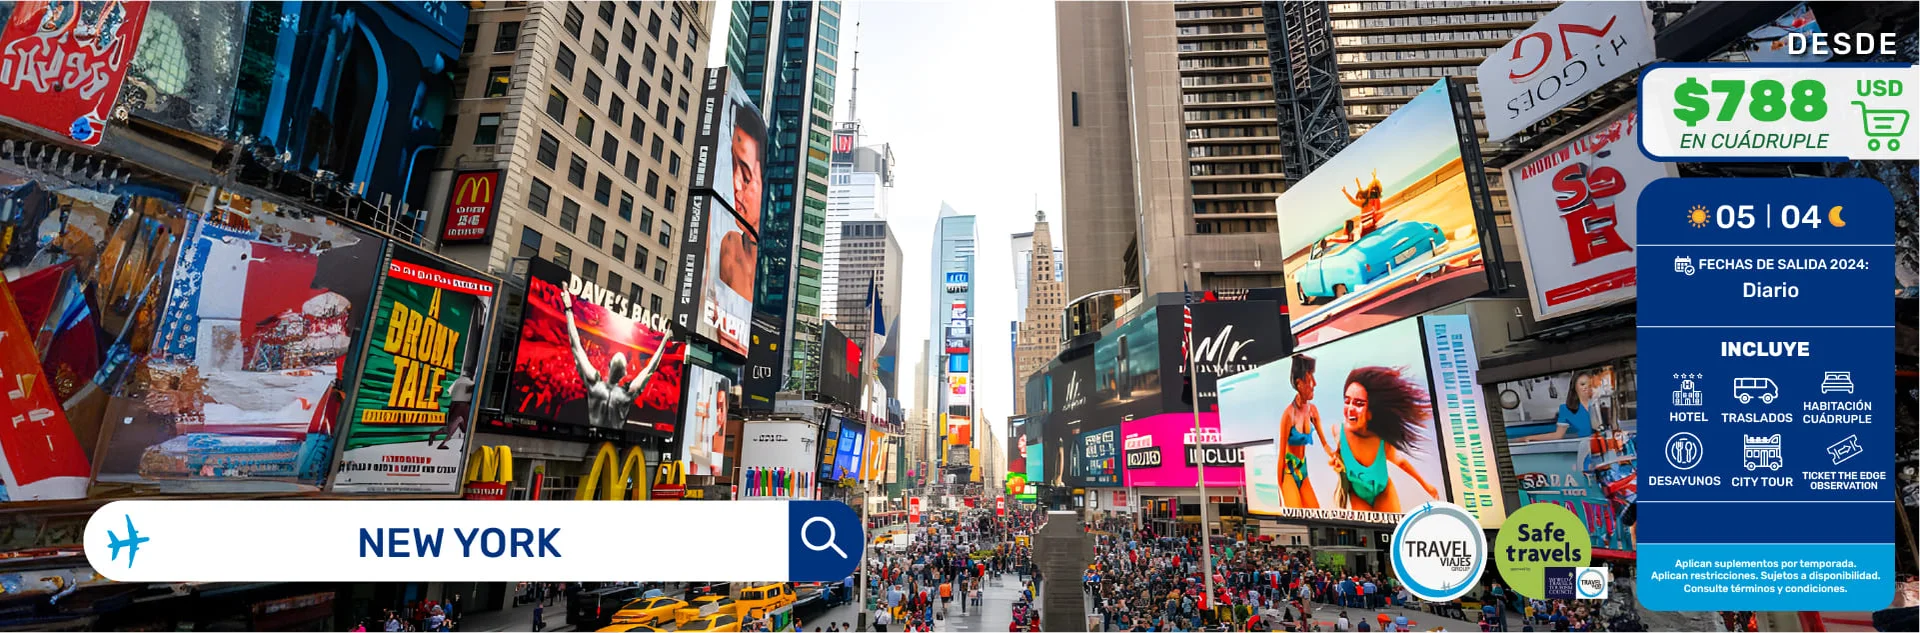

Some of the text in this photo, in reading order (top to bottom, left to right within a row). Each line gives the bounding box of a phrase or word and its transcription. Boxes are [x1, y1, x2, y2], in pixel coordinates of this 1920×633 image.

[428, 287, 442, 320] A
[568, 273, 672, 334] DAVE'S BACK
[384, 300, 460, 370] BRONX
[388, 355, 445, 410] TALE
